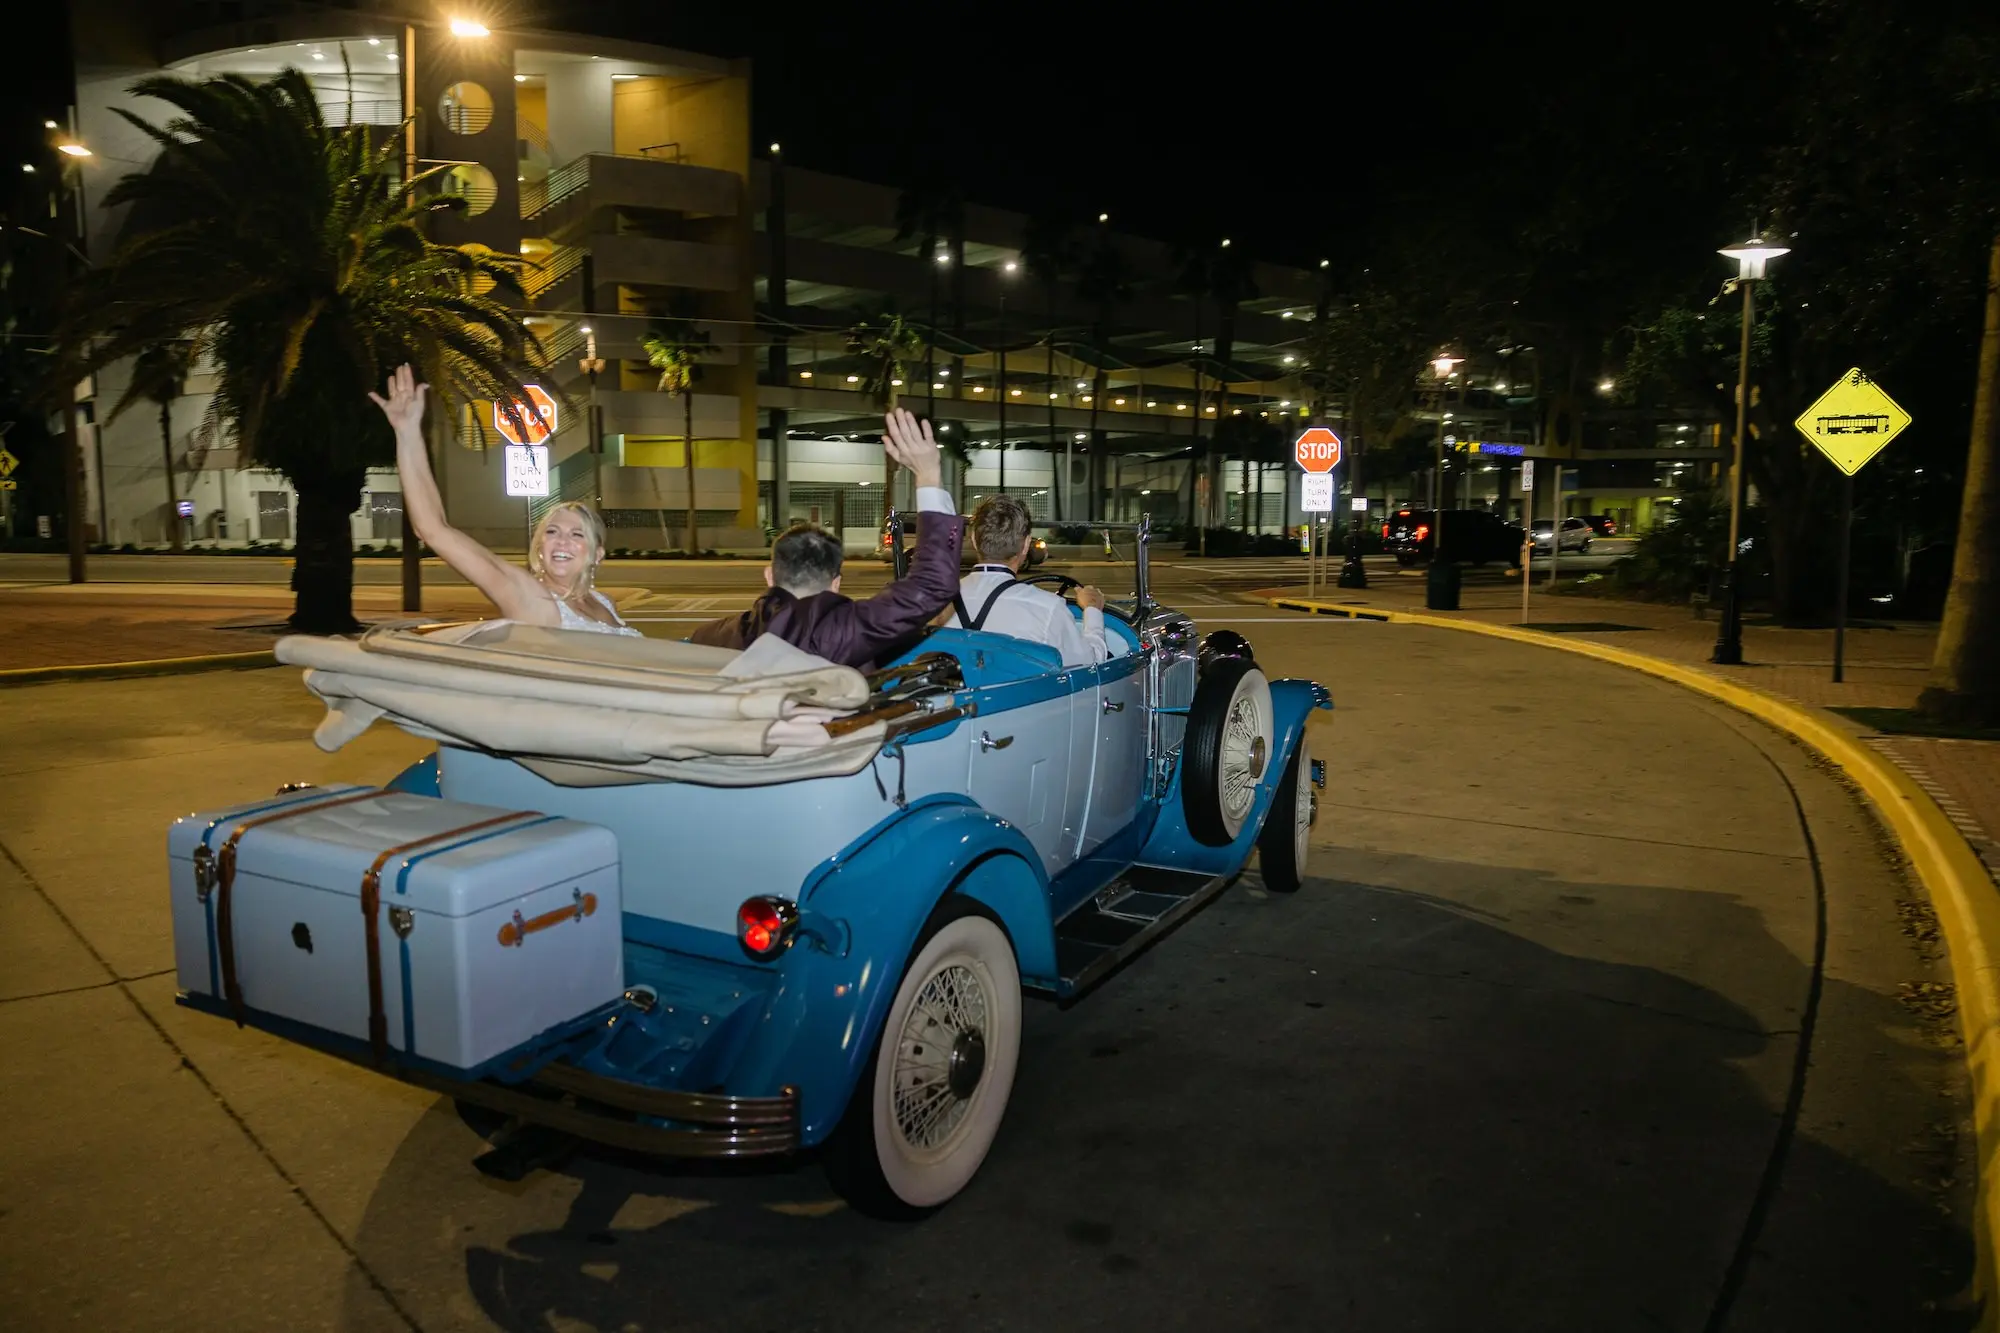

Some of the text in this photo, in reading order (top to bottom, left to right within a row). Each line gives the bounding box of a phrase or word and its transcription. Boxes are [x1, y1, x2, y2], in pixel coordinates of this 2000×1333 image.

[1299, 442, 1338, 460] STOP
[513, 466, 542, 476] TURN
[512, 480, 542, 490] ONLY
[1307, 488, 1328, 496] TURN
[1306, 498, 1328, 507] ONLY
